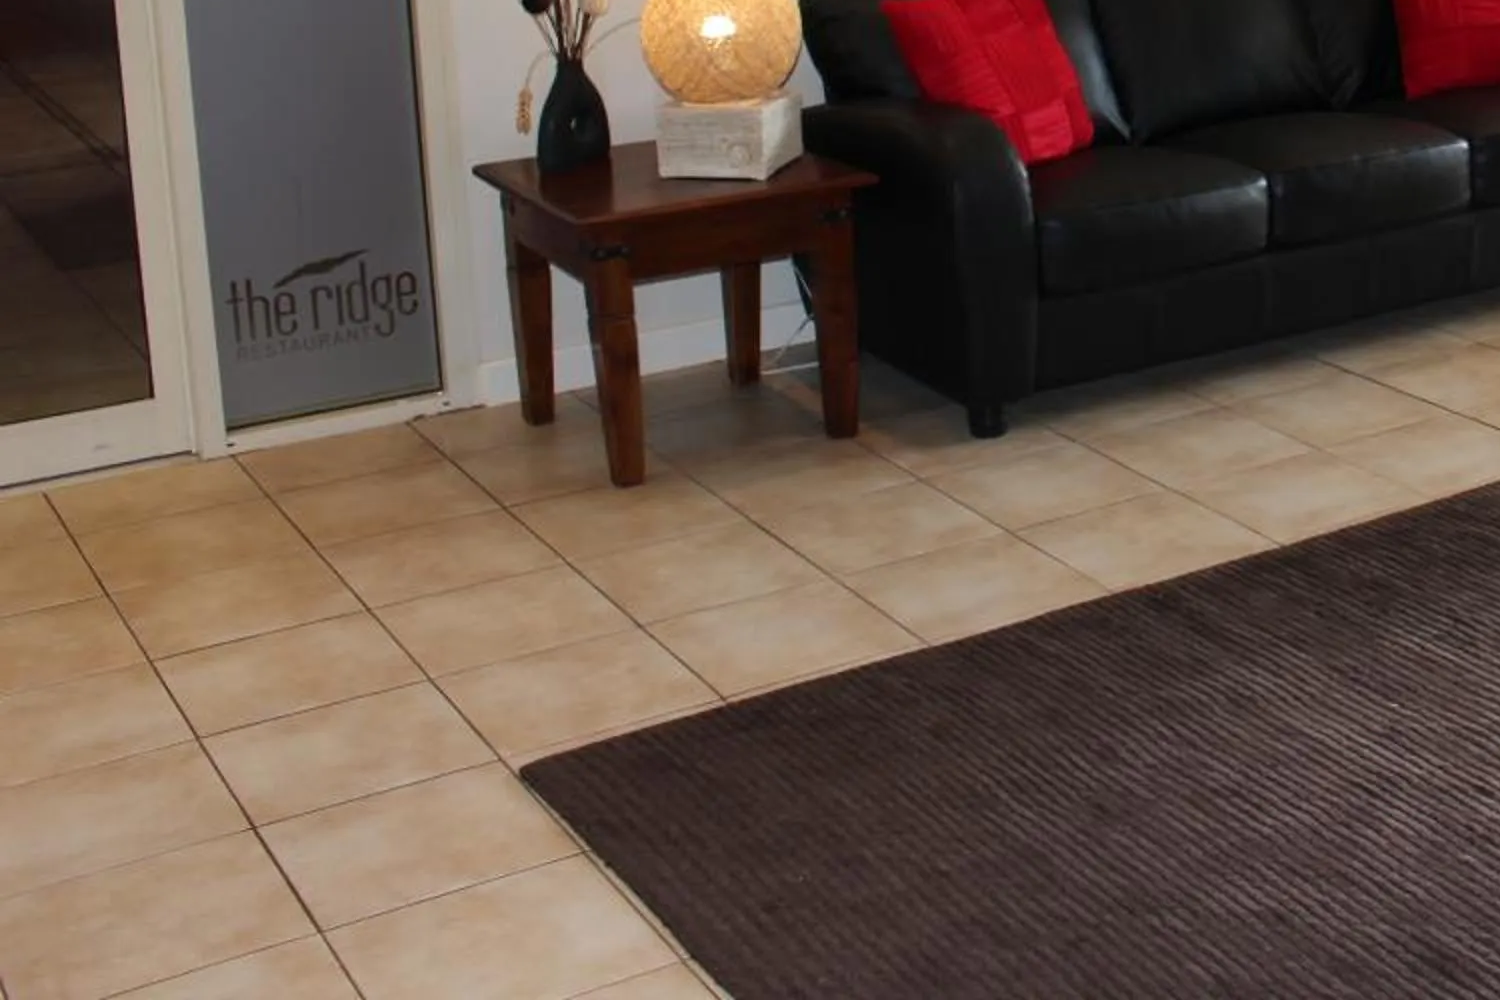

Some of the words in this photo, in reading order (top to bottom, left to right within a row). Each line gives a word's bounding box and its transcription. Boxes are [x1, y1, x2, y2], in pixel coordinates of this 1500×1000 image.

[225, 279, 299, 344] the
[309, 261, 419, 337] ridge
[235, 325, 374, 361] RESTAURANT
